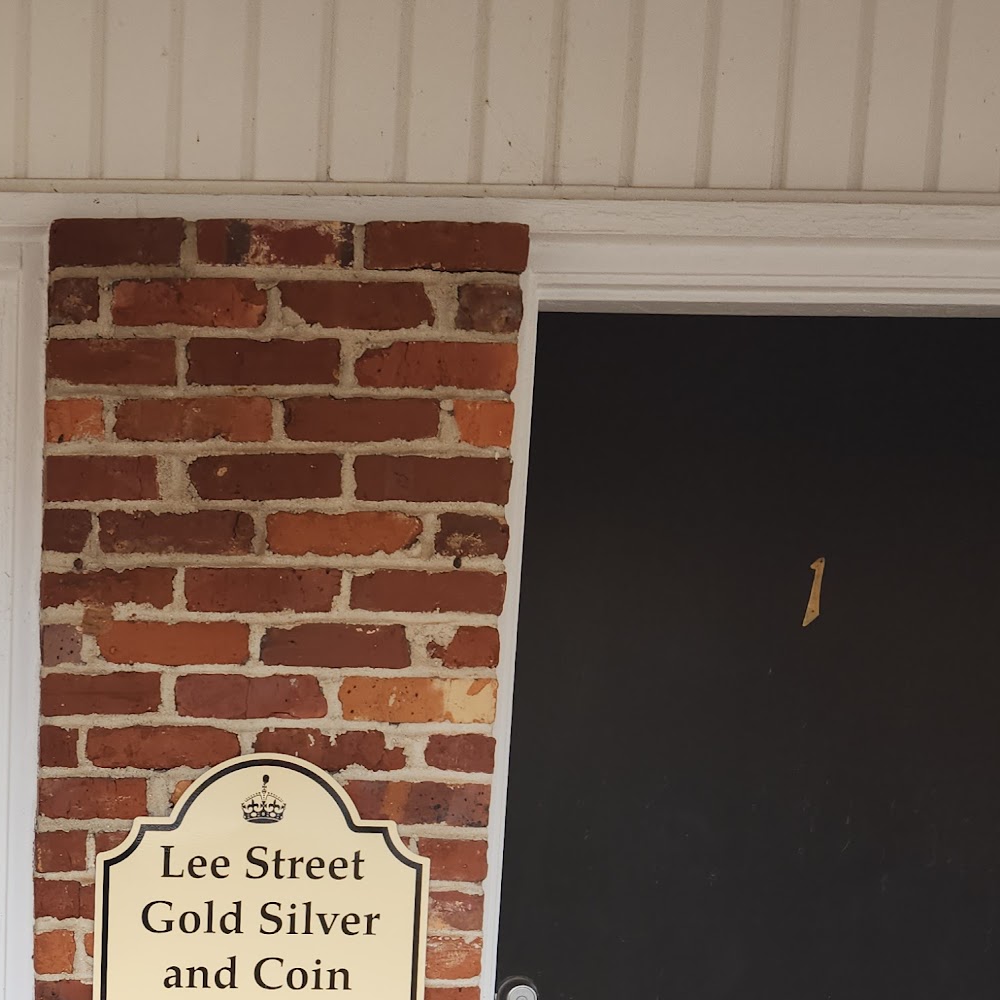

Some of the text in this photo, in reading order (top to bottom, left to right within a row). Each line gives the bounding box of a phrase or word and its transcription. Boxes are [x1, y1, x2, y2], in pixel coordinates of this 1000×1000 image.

[801, 556, 826, 627] 1
[160, 845, 366, 881] Lee Street
[141, 900, 381, 935] Gold Silver
[163, 956, 352, 990] and Coin
